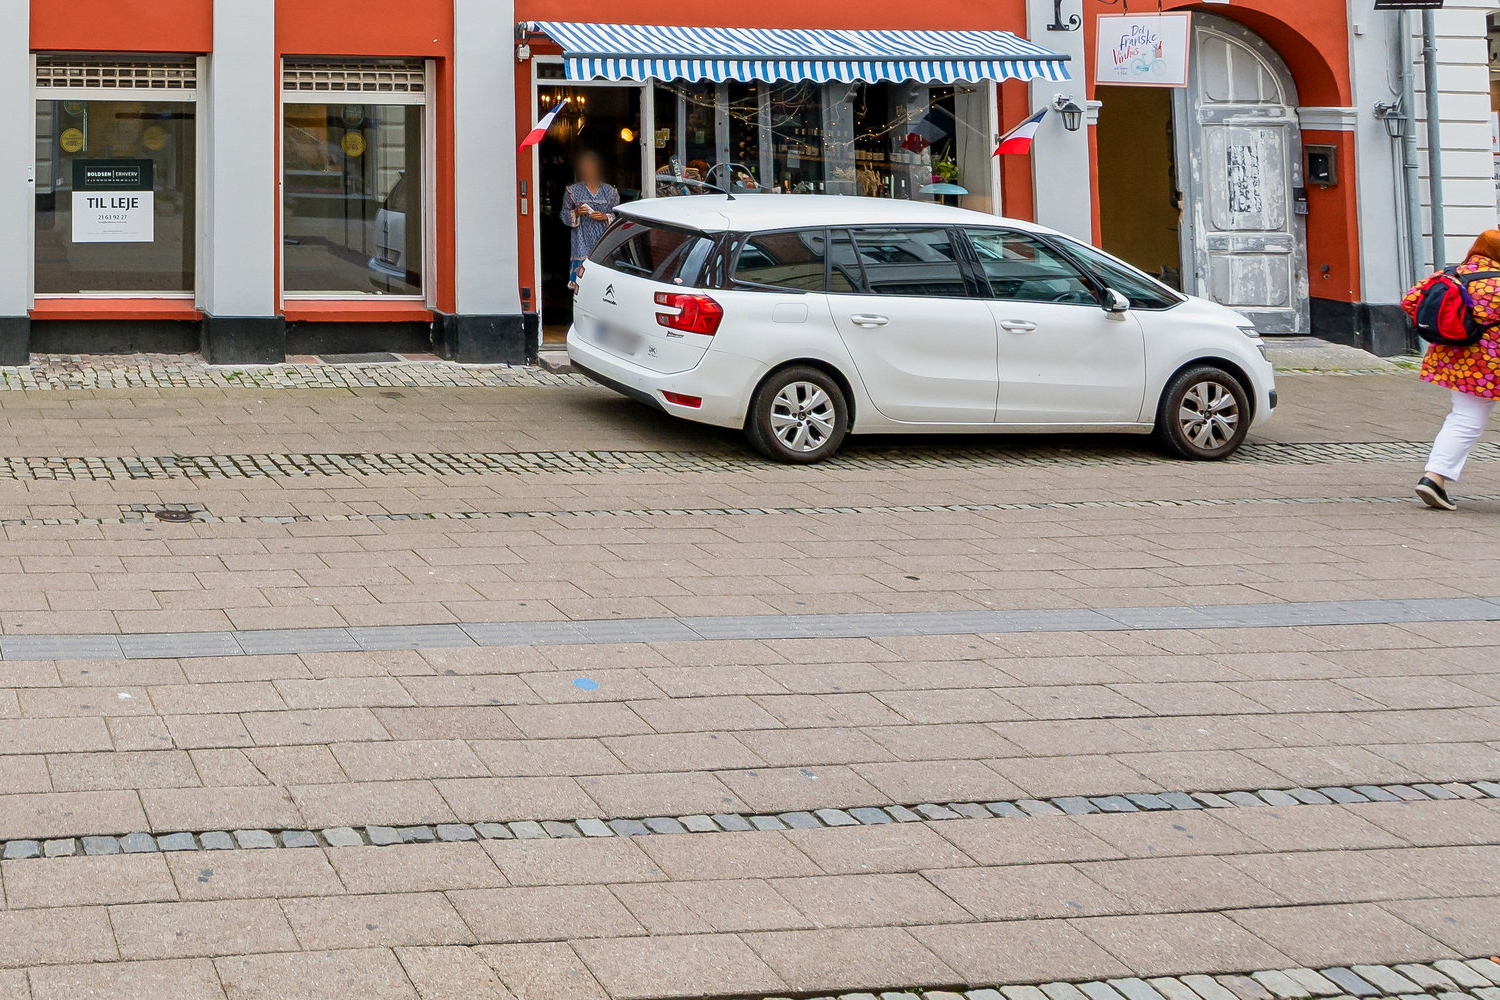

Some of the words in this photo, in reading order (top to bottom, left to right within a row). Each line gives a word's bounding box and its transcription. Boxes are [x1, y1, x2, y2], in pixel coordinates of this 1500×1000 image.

[1131, 25, 1145, 36] Det
[1120, 30, 1157, 50] Franske
[1112, 46, 1139, 65] Vinhus
[87, 198, 107, 208] TIL
[111, 198, 139, 211] LEJE
